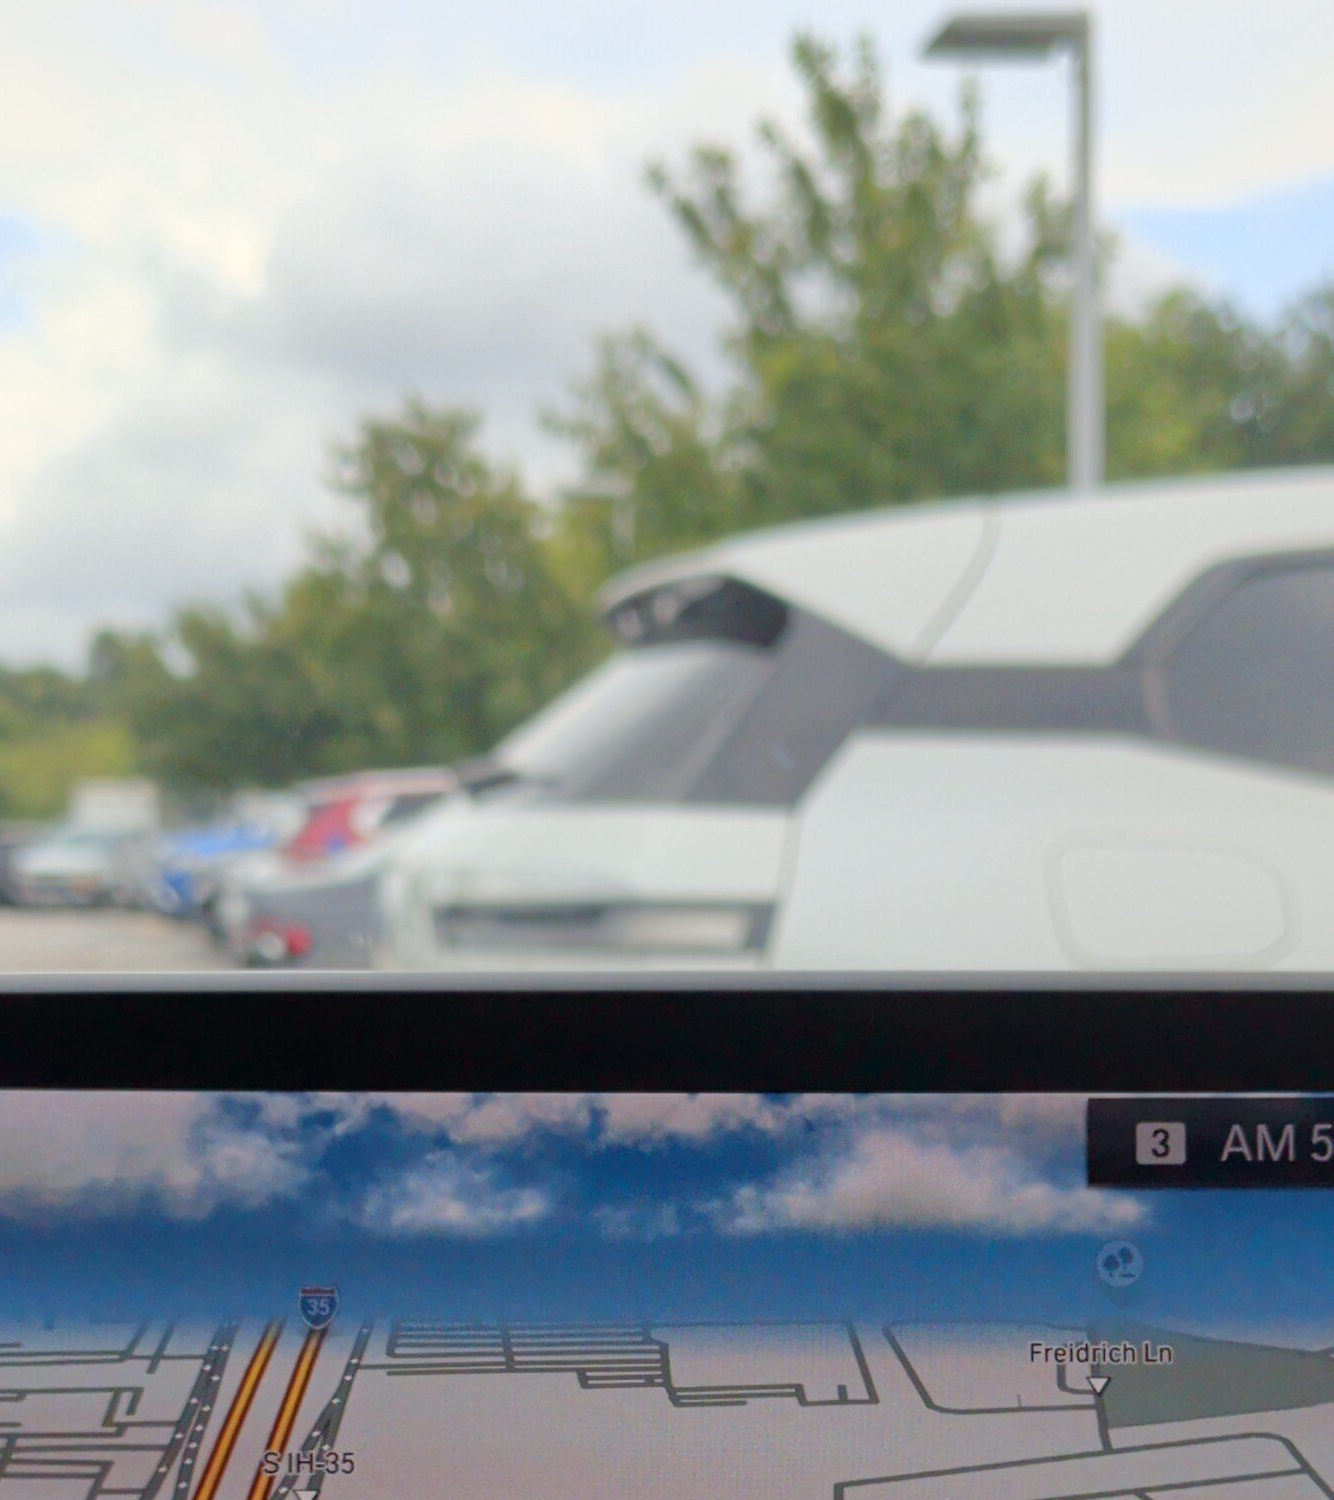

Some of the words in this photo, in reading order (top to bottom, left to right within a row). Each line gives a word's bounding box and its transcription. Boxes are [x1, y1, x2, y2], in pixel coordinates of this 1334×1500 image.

[1151, 1128, 1170, 1158] 3
[1221, 1124, 1296, 1162] AM
[307, 1300, 330, 1316] 35
[1030, 1342, 1136, 1363] Freidrich
[1144, 1342, 1173, 1363] Ln
[264, 1452, 280, 1475] S
[288, 1452, 355, 1475] IH-35
